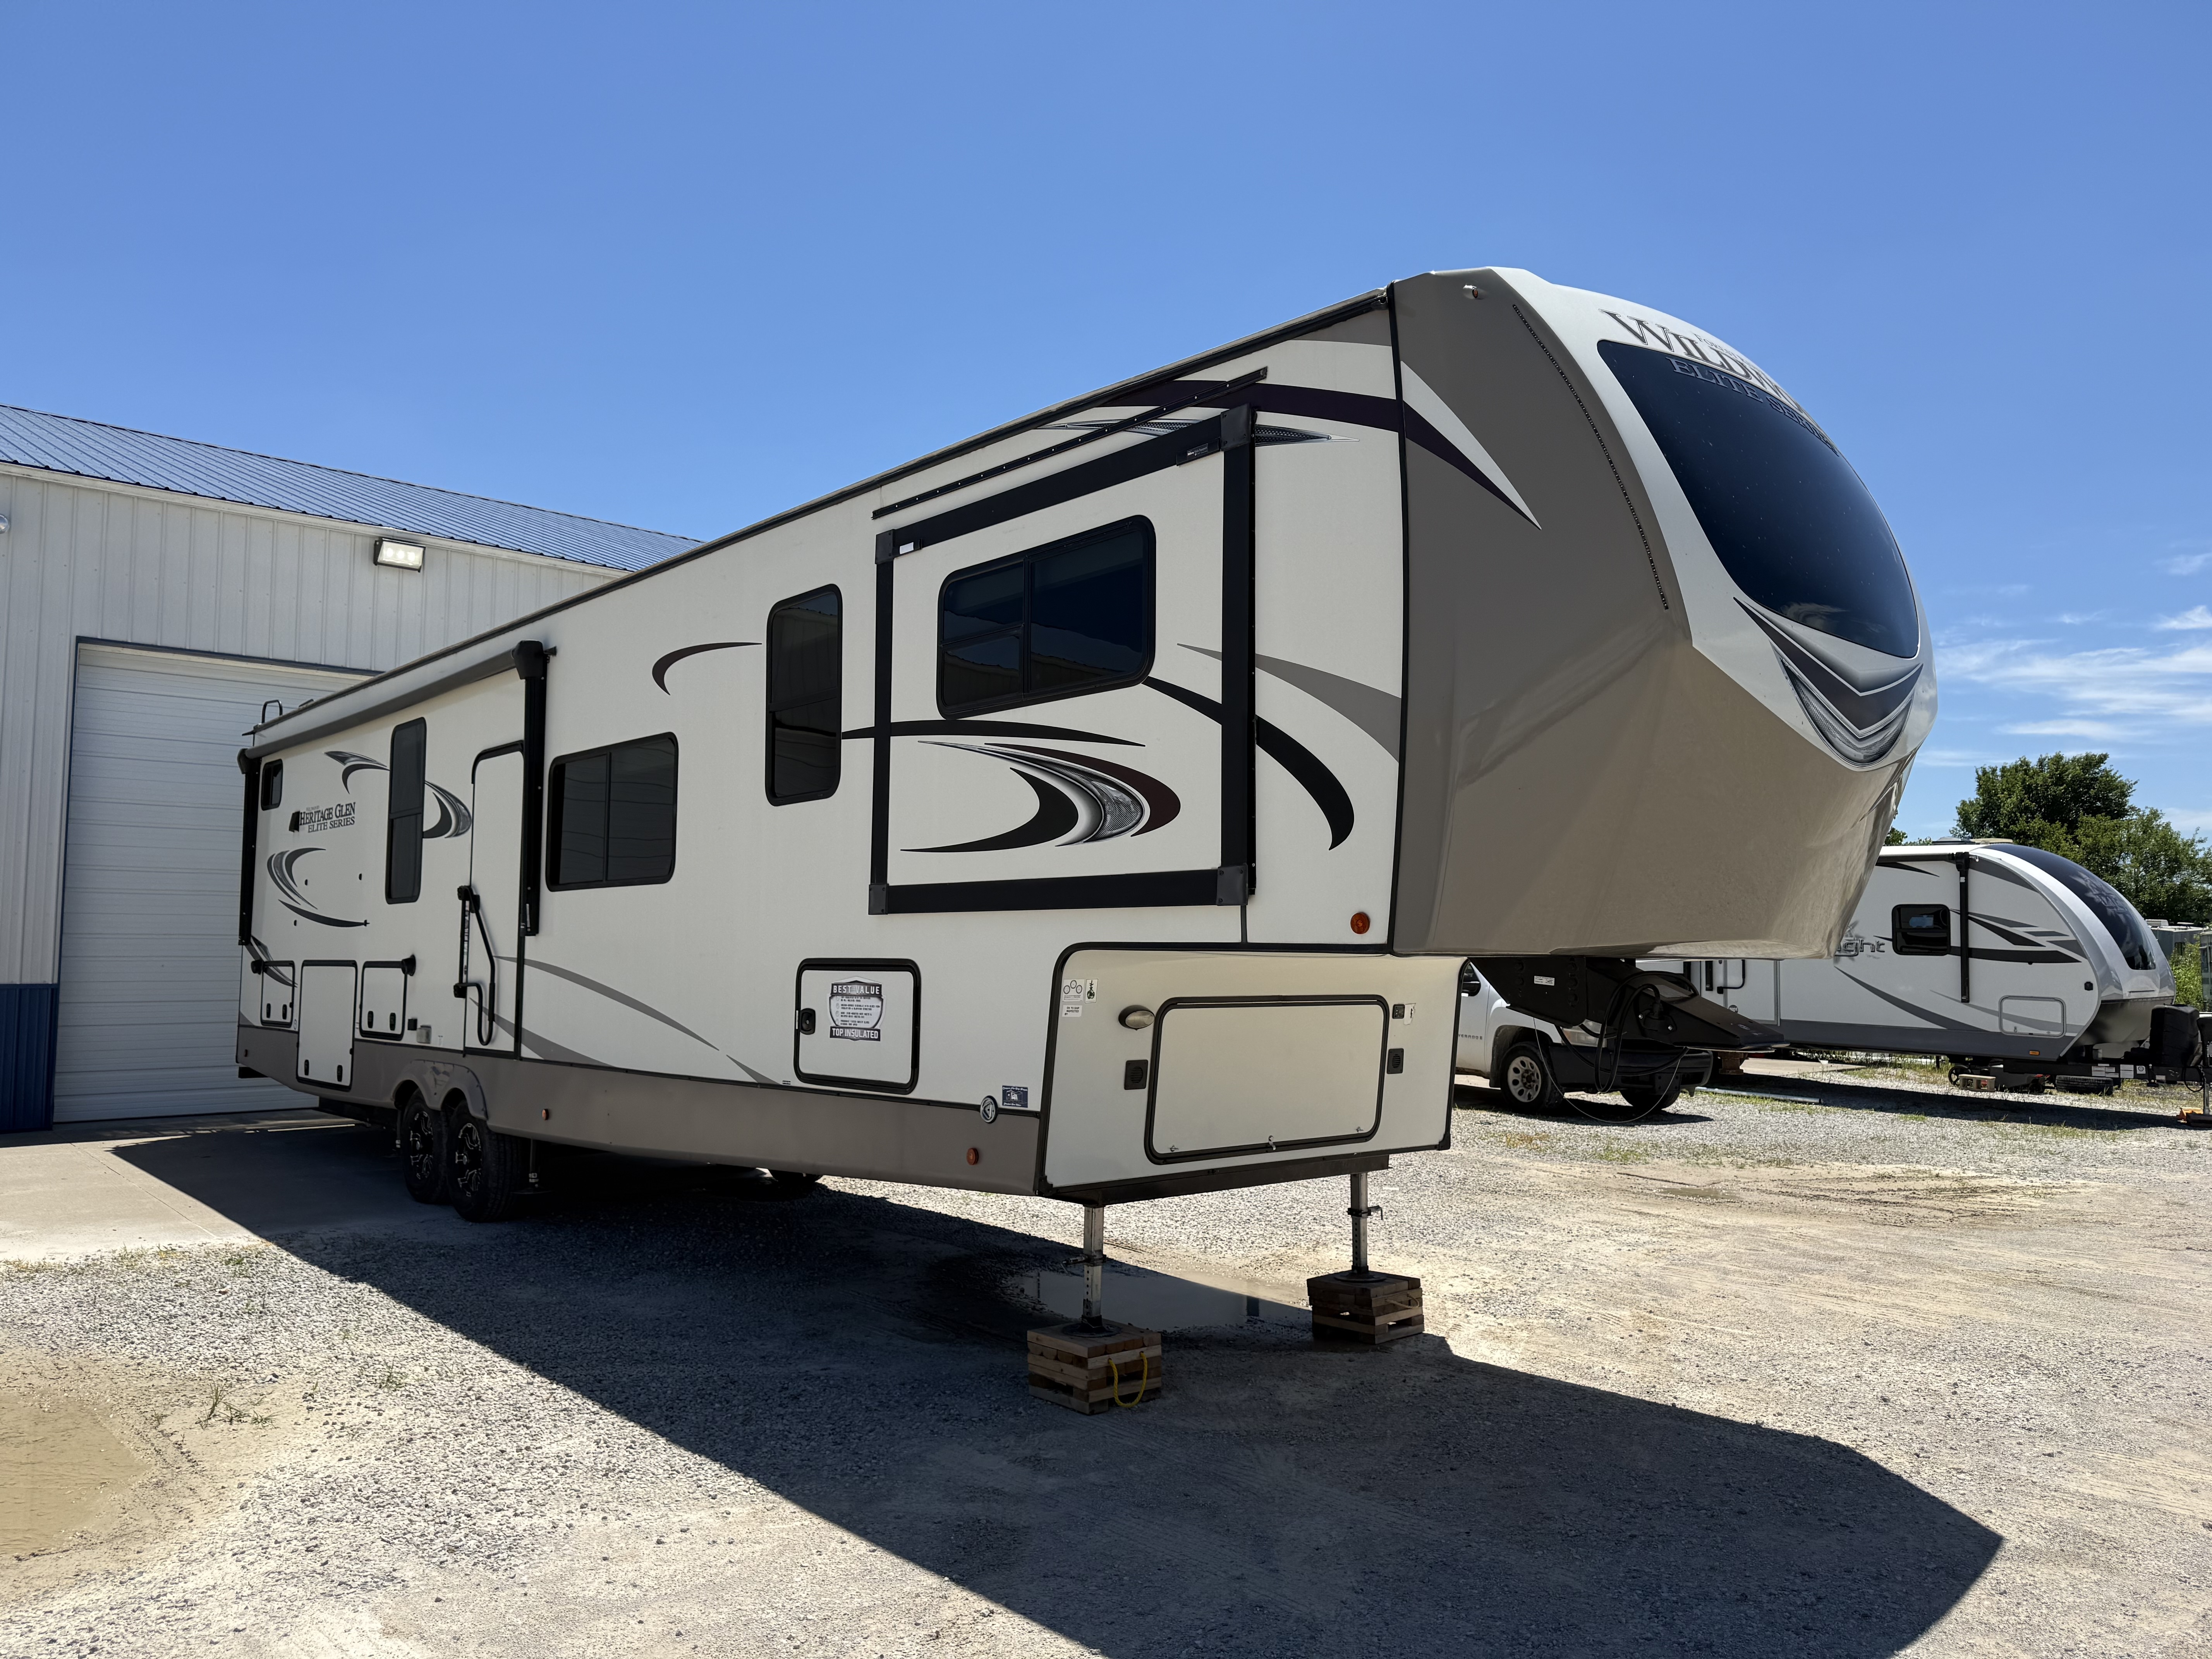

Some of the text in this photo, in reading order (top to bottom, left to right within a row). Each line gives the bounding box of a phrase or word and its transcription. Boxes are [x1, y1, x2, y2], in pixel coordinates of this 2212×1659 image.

[1666, 357, 1763, 402] ELITE
[299, 802, 356, 826] HERITAGE GLEN
[308, 816, 355, 833] ELITE SERIES
[855, 986, 879, 994] VALUE
[832, 1028, 878, 1039] TOP INSULATED
